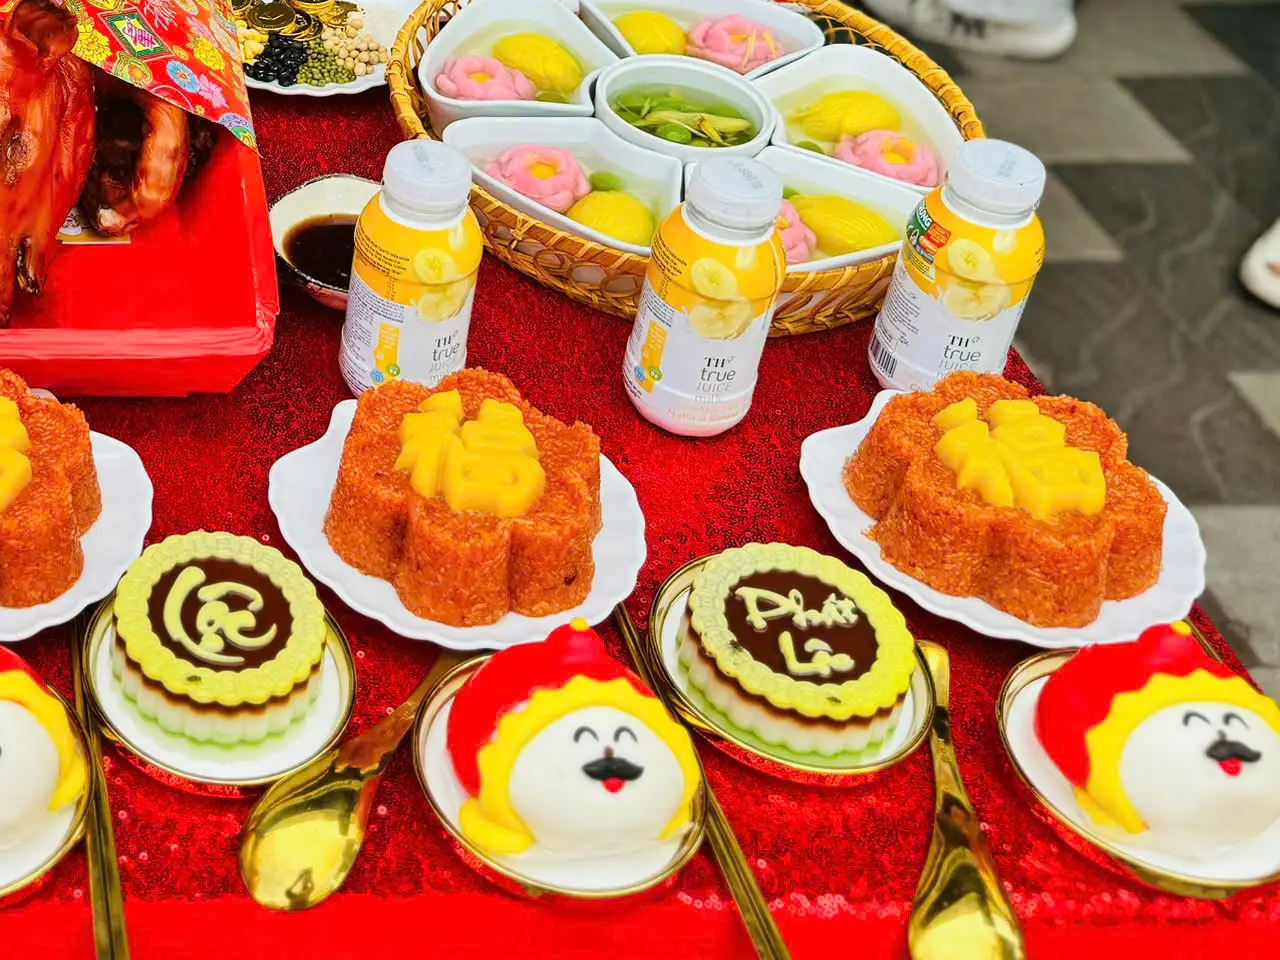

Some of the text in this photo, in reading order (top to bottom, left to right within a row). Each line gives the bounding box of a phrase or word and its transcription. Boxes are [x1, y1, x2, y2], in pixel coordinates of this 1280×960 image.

[433, 343, 460, 362] true
[944, 345, 981, 361] true
[701, 368, 736, 382] true
[697, 381, 733, 393] JUICE
